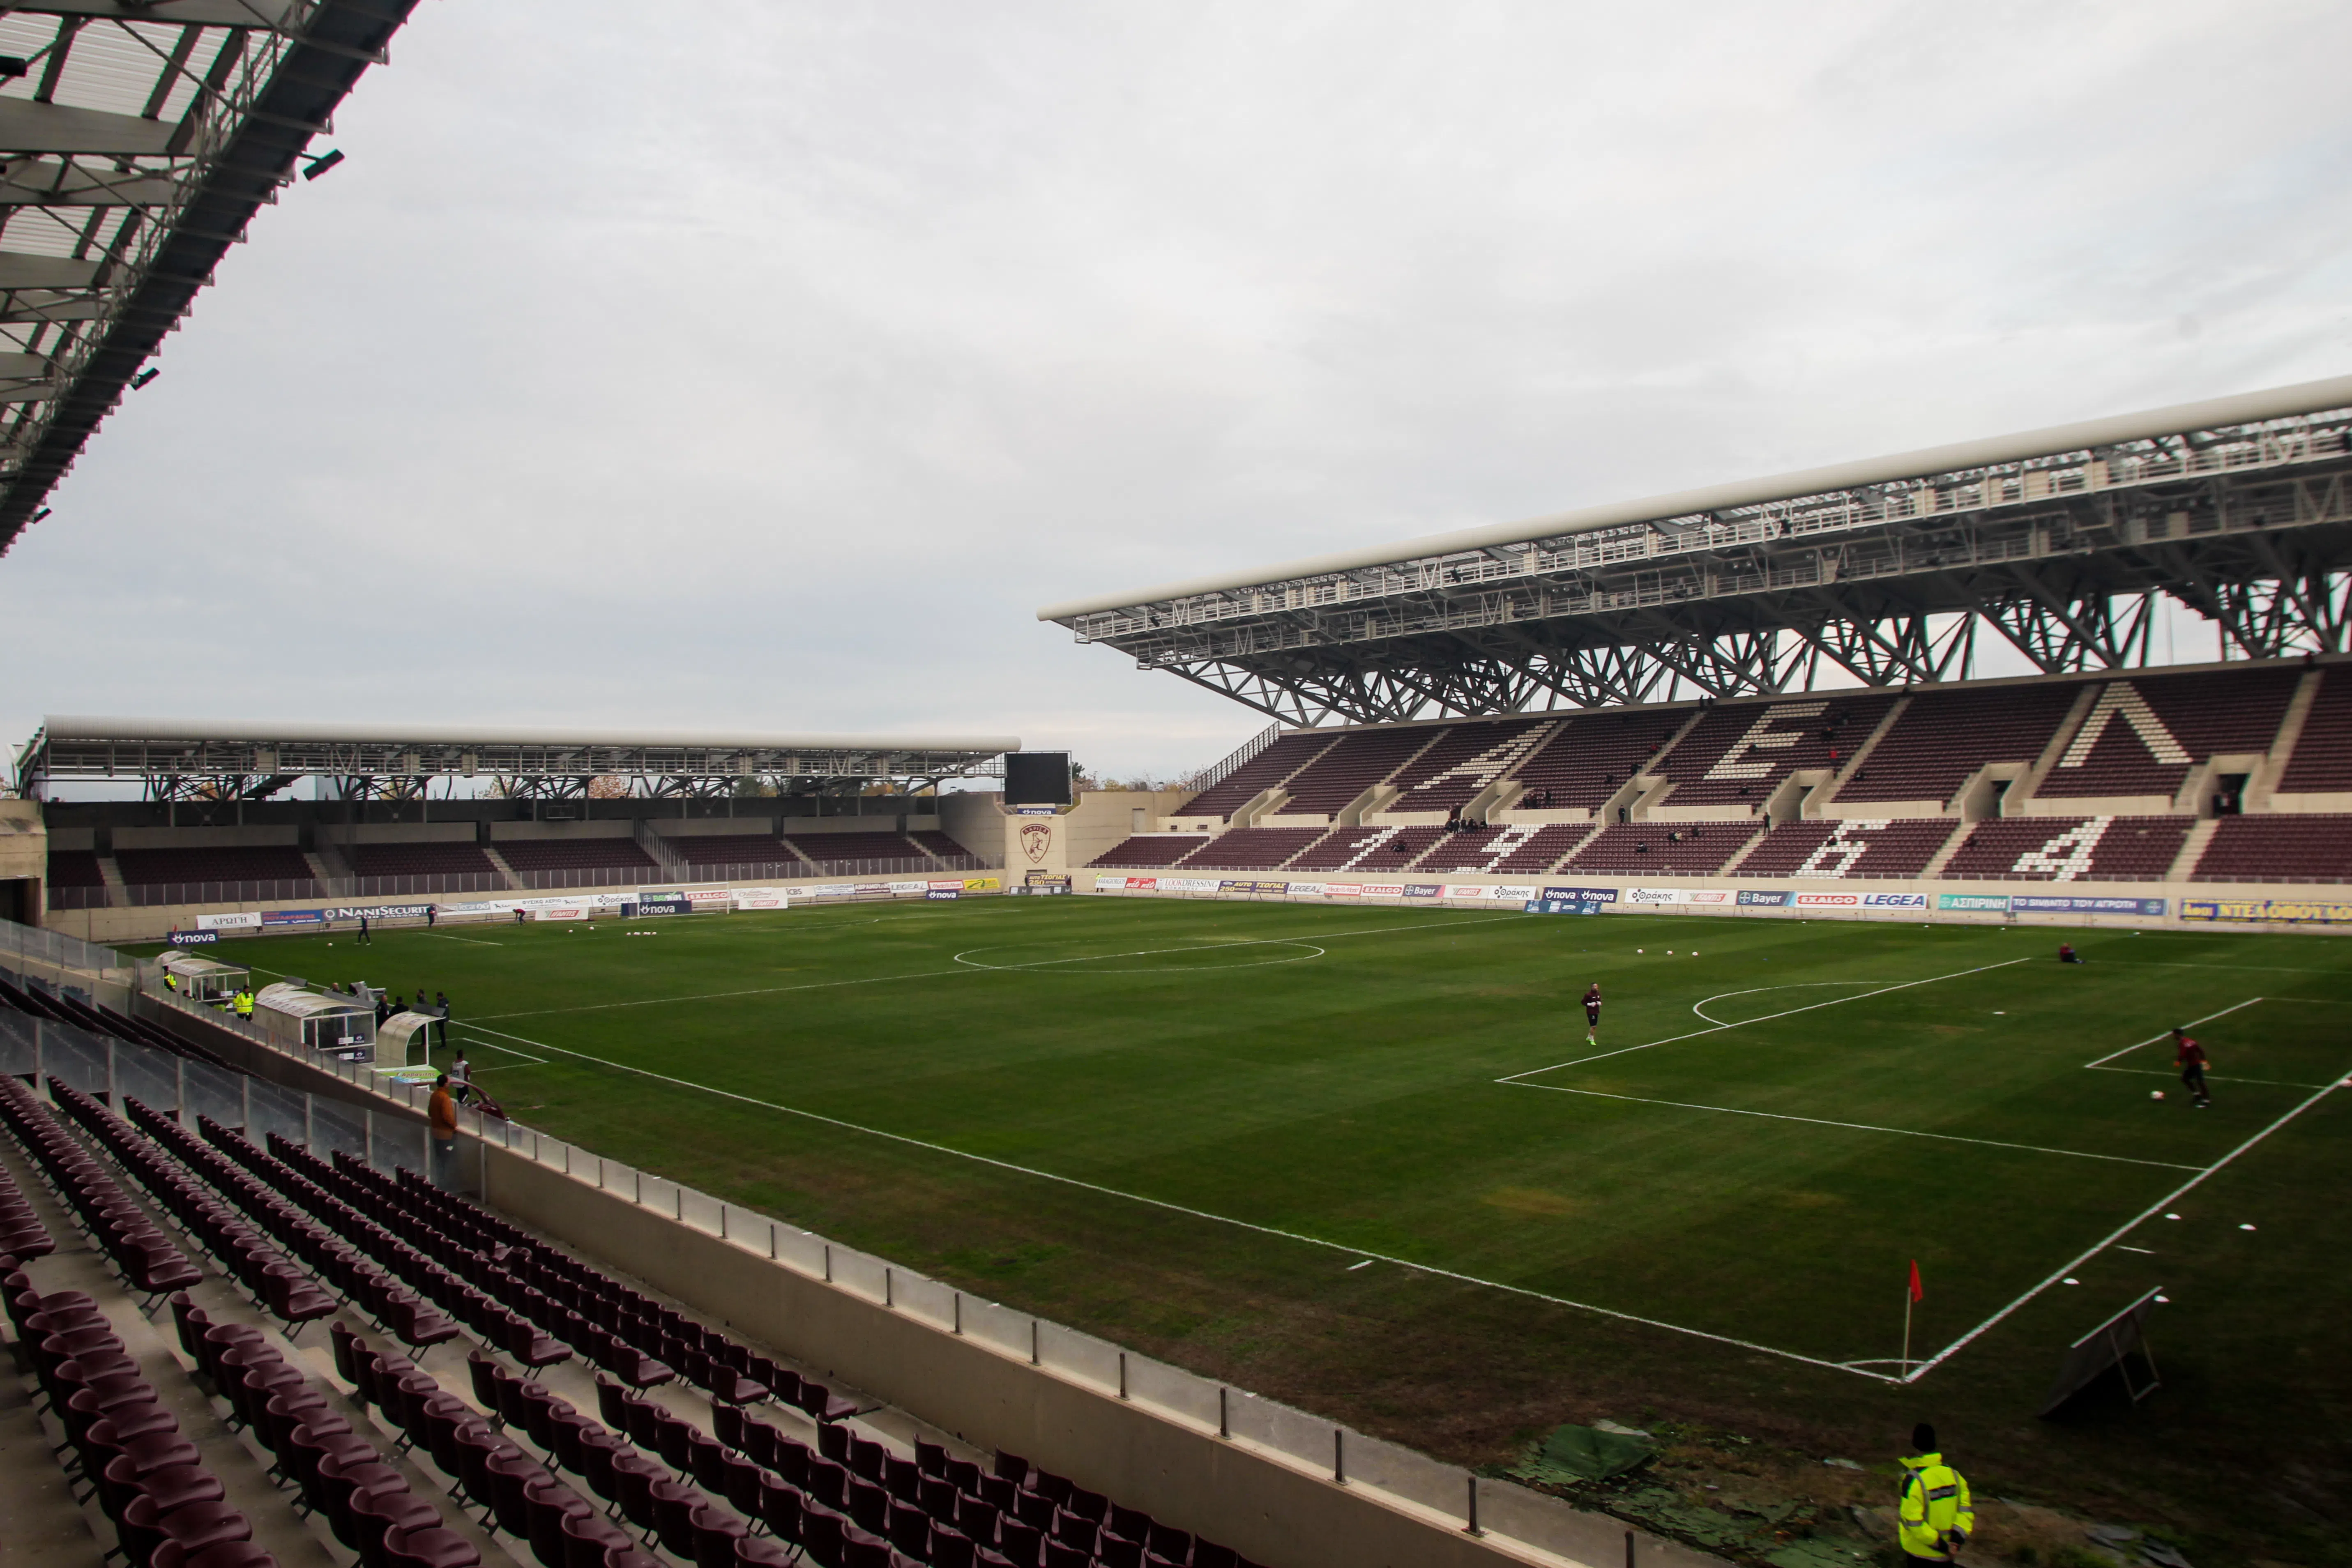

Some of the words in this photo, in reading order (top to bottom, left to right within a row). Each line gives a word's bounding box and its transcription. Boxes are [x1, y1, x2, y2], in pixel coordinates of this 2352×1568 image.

[1414, 886, 1435, 896] Bayer
[1590, 893, 1614, 901] nova
[1752, 893, 1782, 904] Bayer
[1864, 895, 1925, 905] LEGEA
[1951, 897, 2007, 909] ΑΣΠΙΡΙΝΗ
[212, 916, 248, 925] ΑΡΩΓΗ
[185, 934, 216, 943] nova
